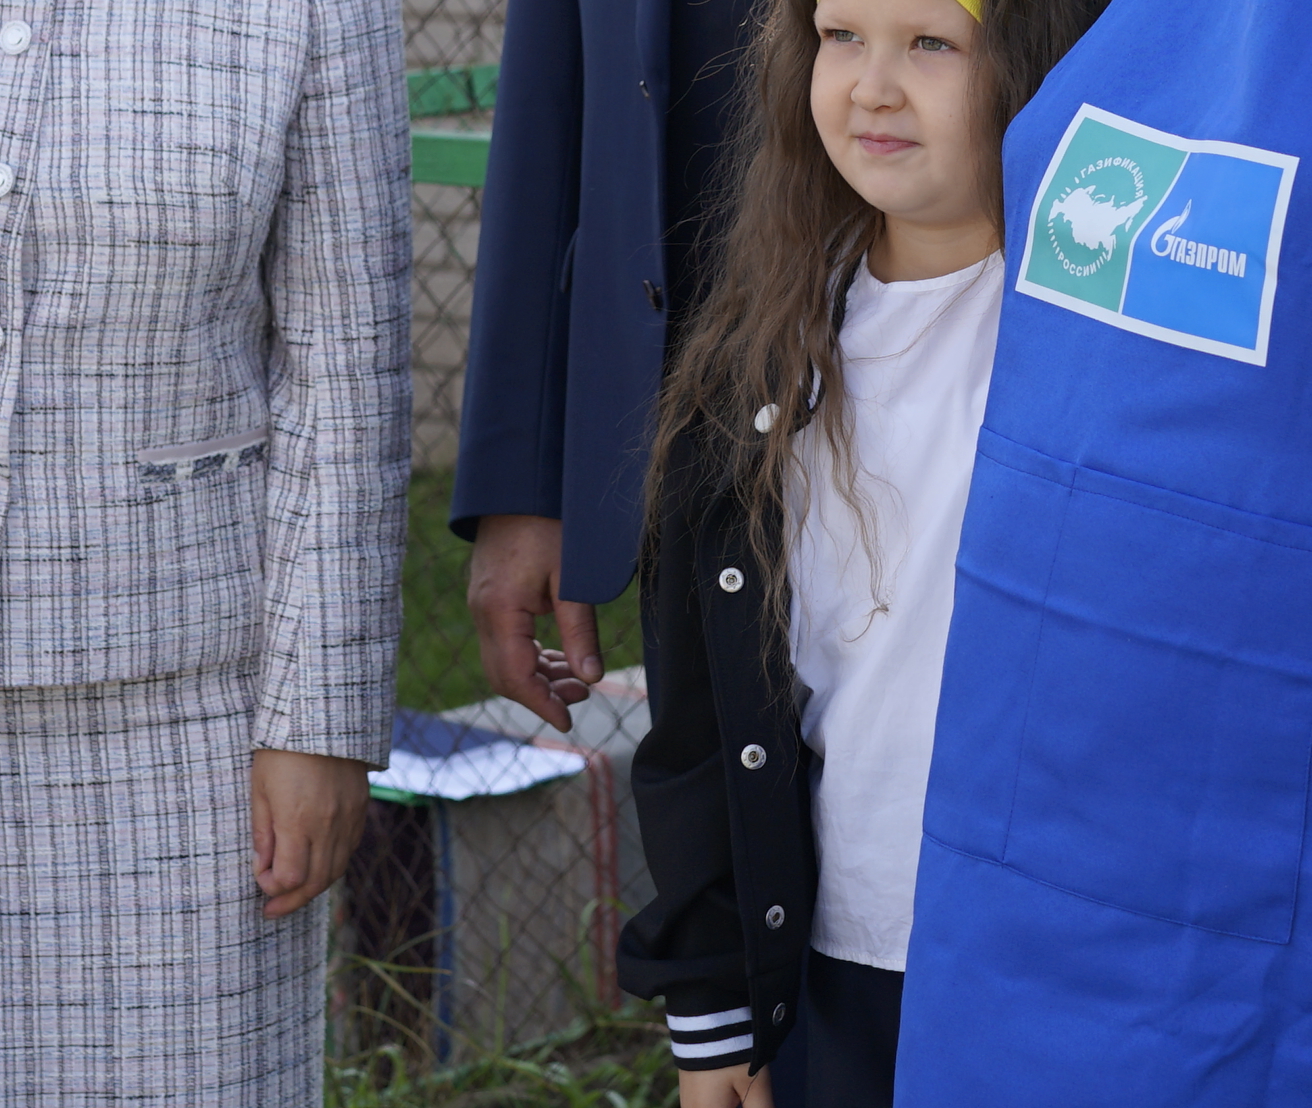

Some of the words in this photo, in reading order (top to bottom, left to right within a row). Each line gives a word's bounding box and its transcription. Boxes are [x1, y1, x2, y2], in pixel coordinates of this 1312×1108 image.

[1080, 156, 1144, 199] ГАЗИФИКАЦИЯ
[1057, 251, 1097, 277] РОССИИ
[1168, 235, 1247, 279] ГАЗПРОМ
